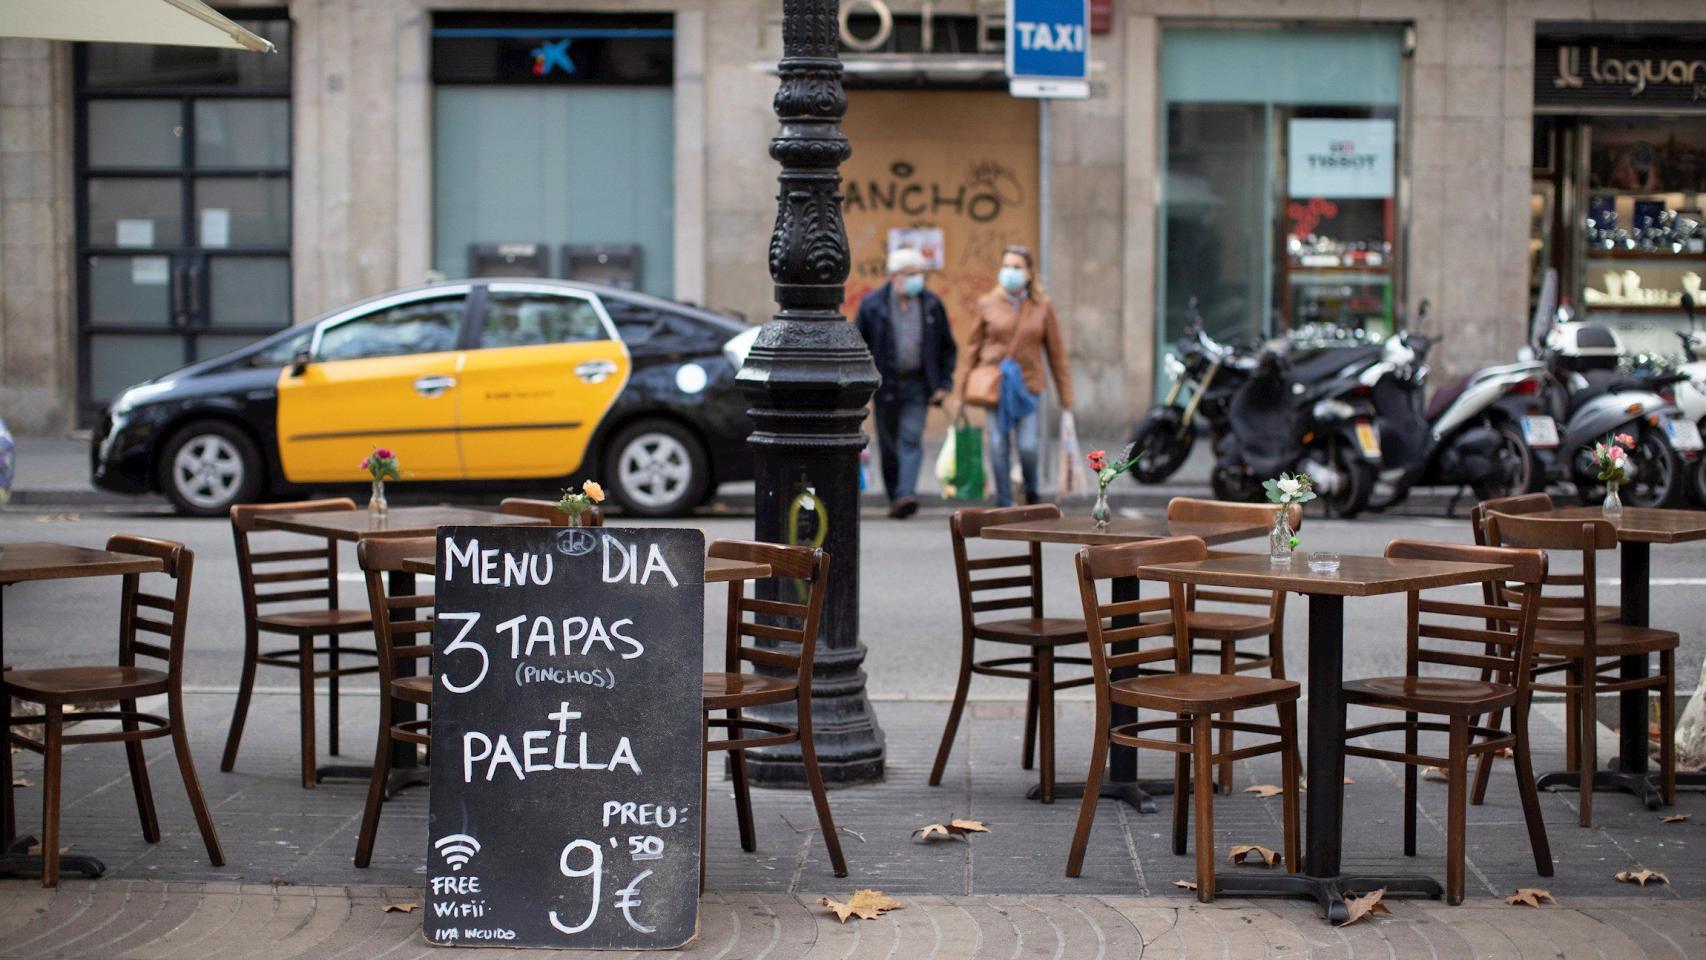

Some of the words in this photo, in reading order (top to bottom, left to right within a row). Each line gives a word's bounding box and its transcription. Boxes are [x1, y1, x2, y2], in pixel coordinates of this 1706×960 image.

[1016, 22, 1083, 52] TAXI
[1307, 153, 1378, 169] TISSOT
[444, 537, 553, 587] MENU
[602, 534, 679, 588] DIA
[438, 612, 489, 693] 3
[496, 615, 644, 659] TAPAS
[515, 662, 616, 690] (PINCHOS)
[430, 876, 482, 896] FREE
[435, 927, 459, 941] IVA
